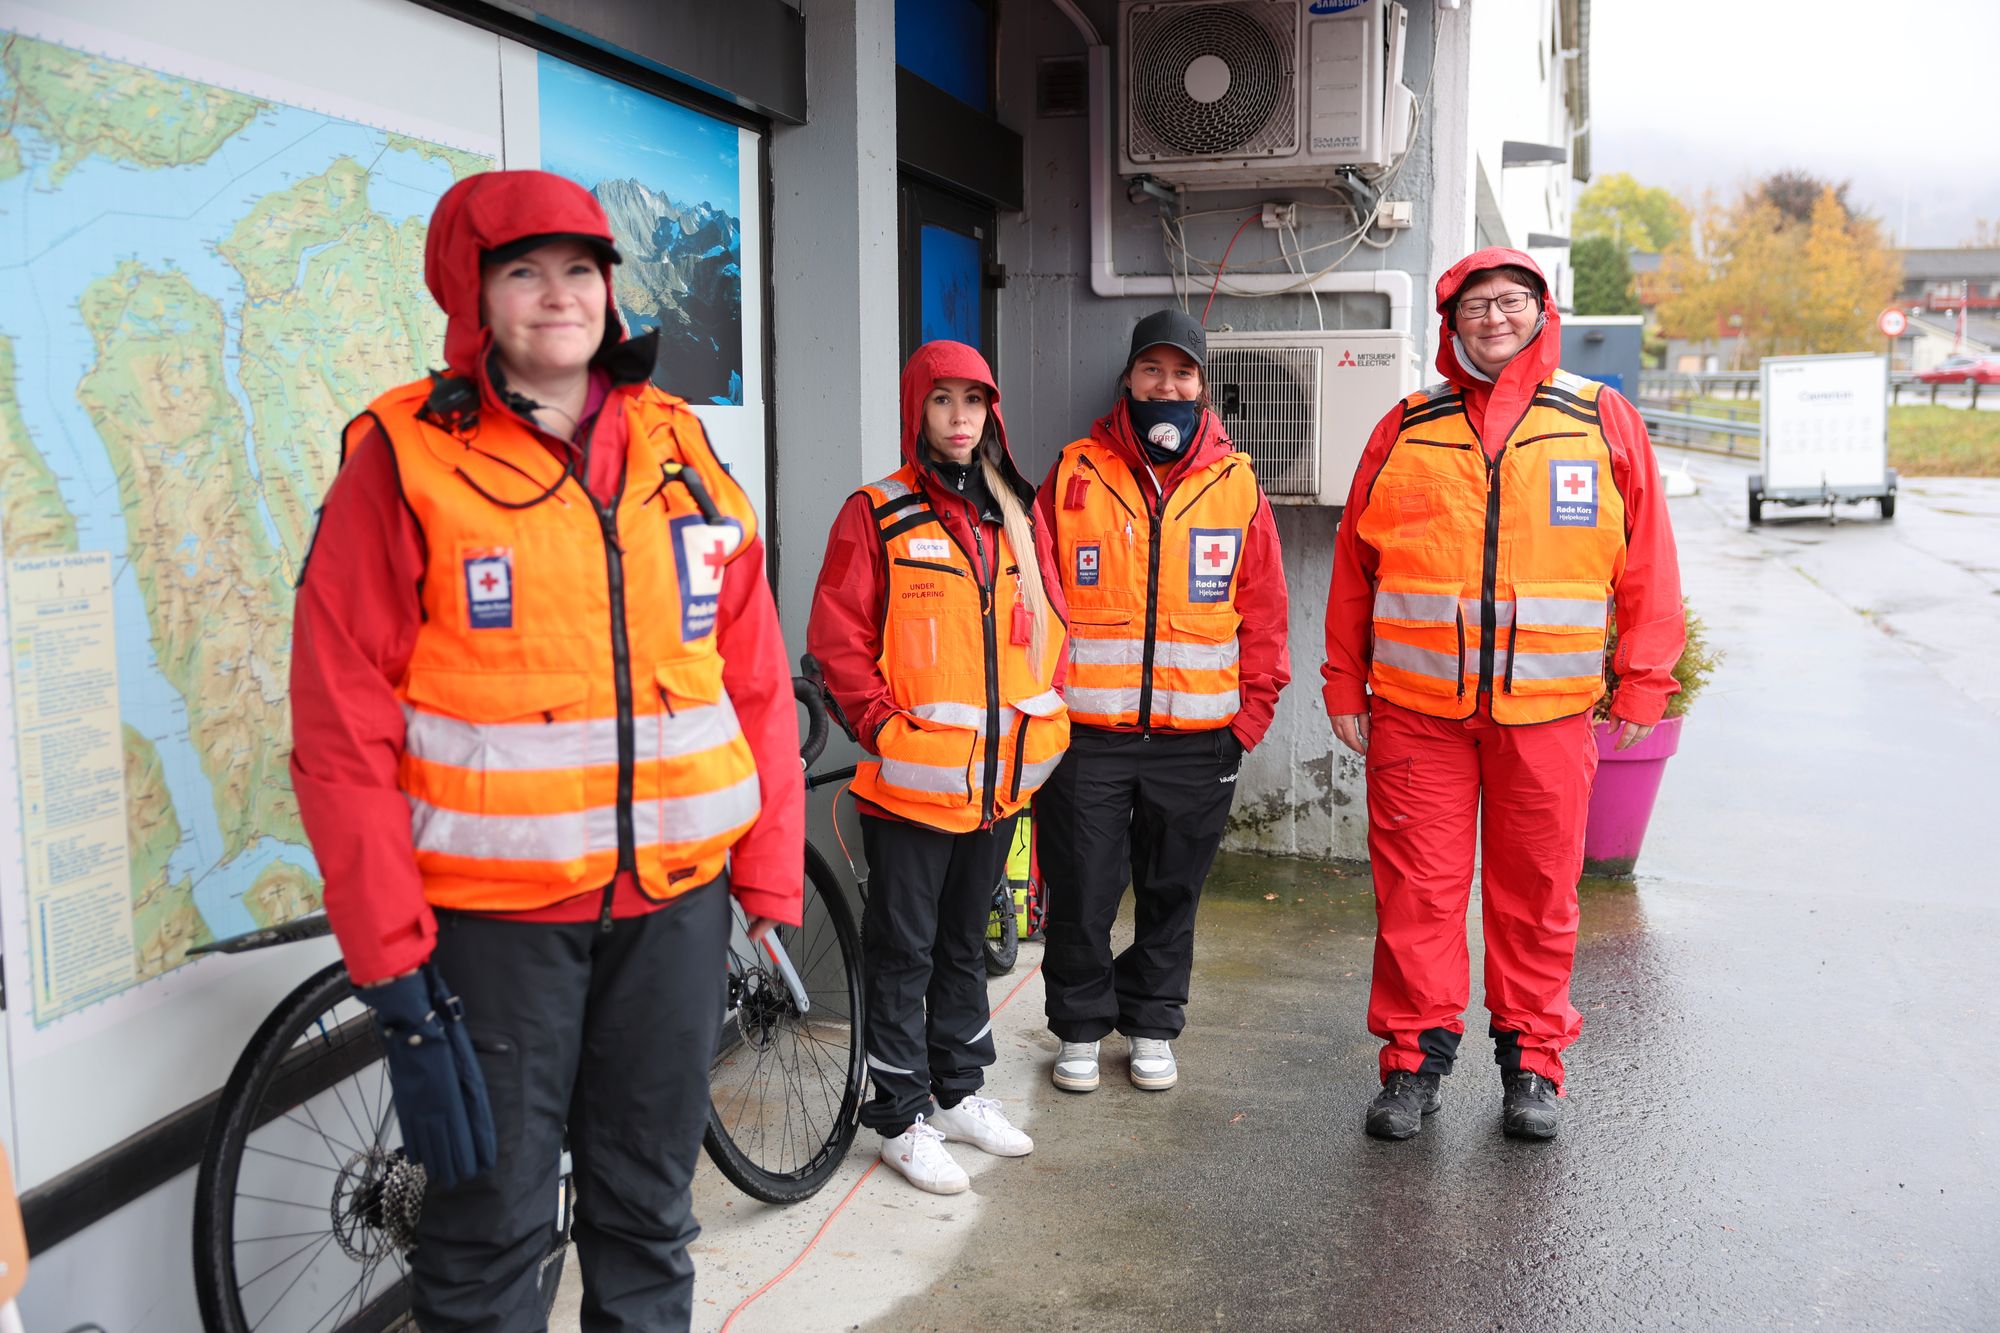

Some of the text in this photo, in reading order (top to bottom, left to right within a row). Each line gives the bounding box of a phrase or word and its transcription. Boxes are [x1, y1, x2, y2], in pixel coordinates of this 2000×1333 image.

[1556, 505, 1592, 514] Røde Kors
[909, 582, 935, 591] UNDER
[1195, 580, 1217, 588] Røde
[901, 591, 945, 600] OPPLÆRING
